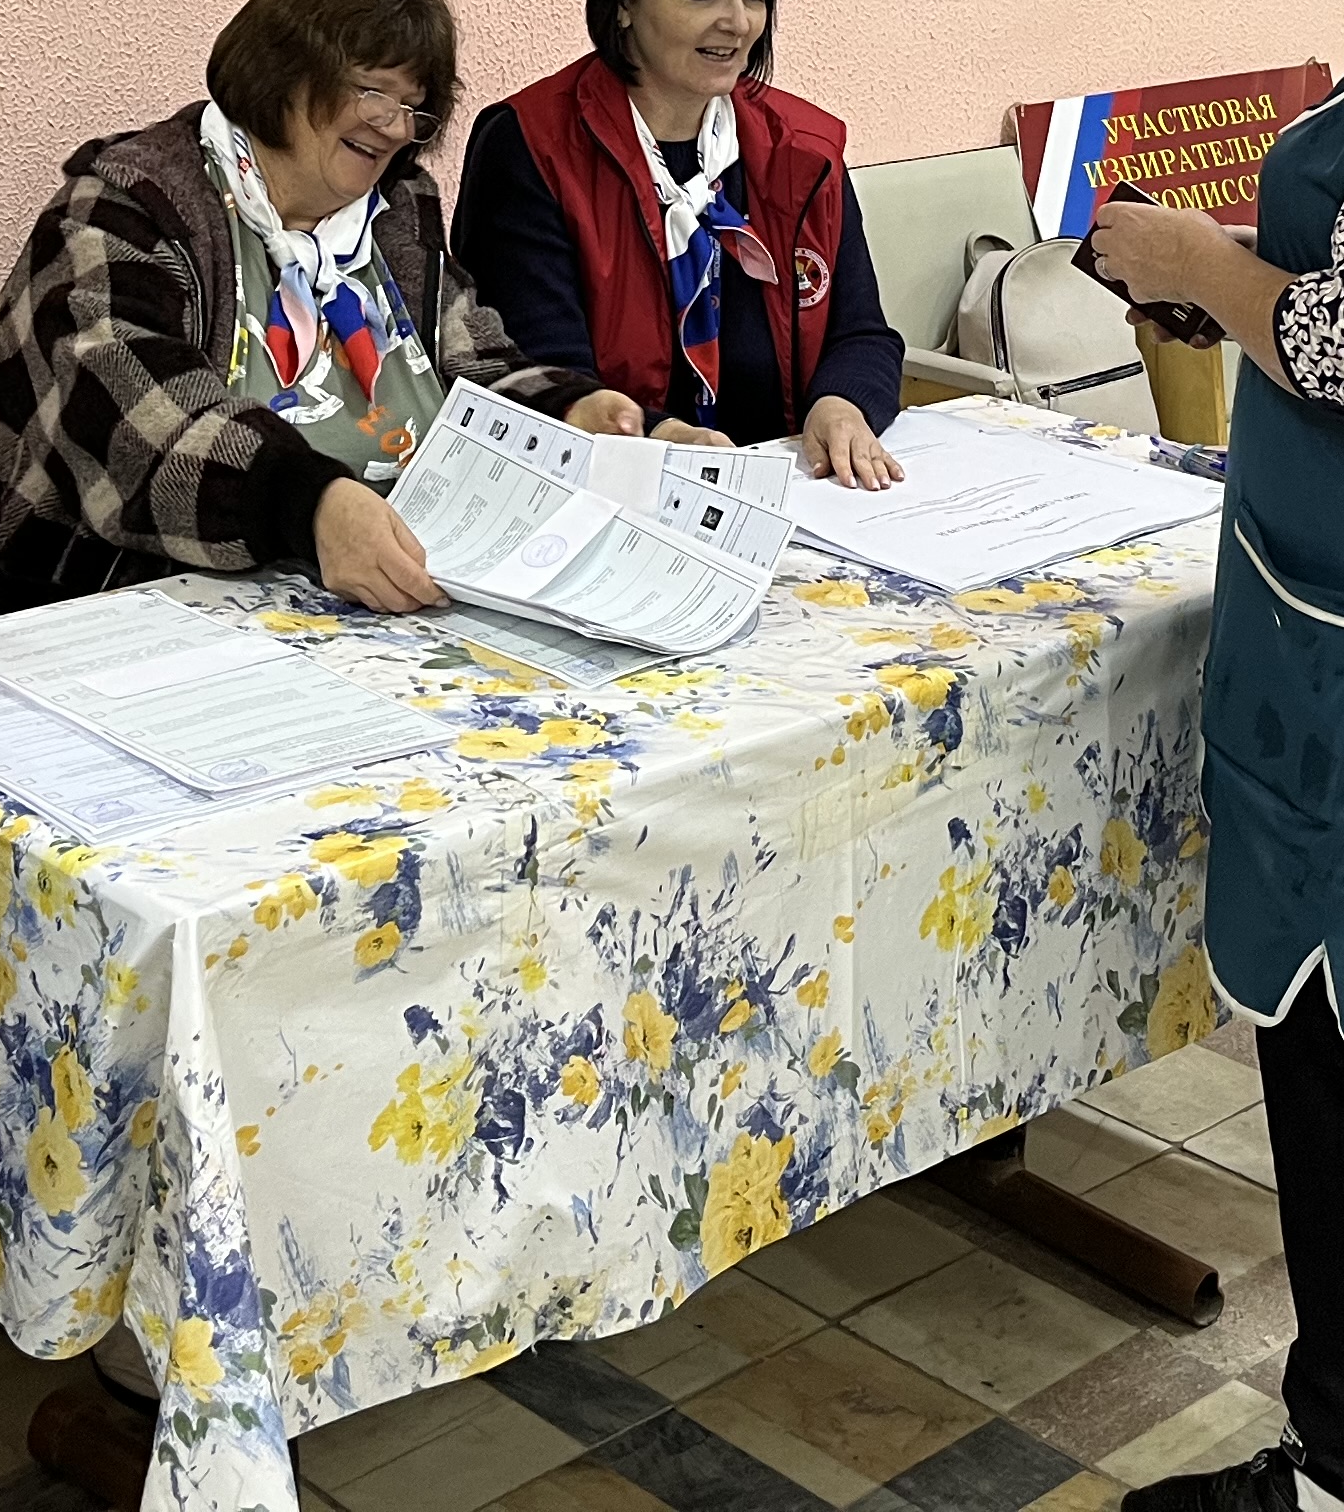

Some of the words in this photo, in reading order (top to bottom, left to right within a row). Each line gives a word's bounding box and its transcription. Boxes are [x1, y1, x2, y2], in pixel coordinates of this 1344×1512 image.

[1101, 93, 1278, 145] УЧАСТКОВАЯ
[1083, 132, 1278, 188] ИЗБИРАТЕЛЬН
[1149, 174, 1260, 210] ОМИСС
